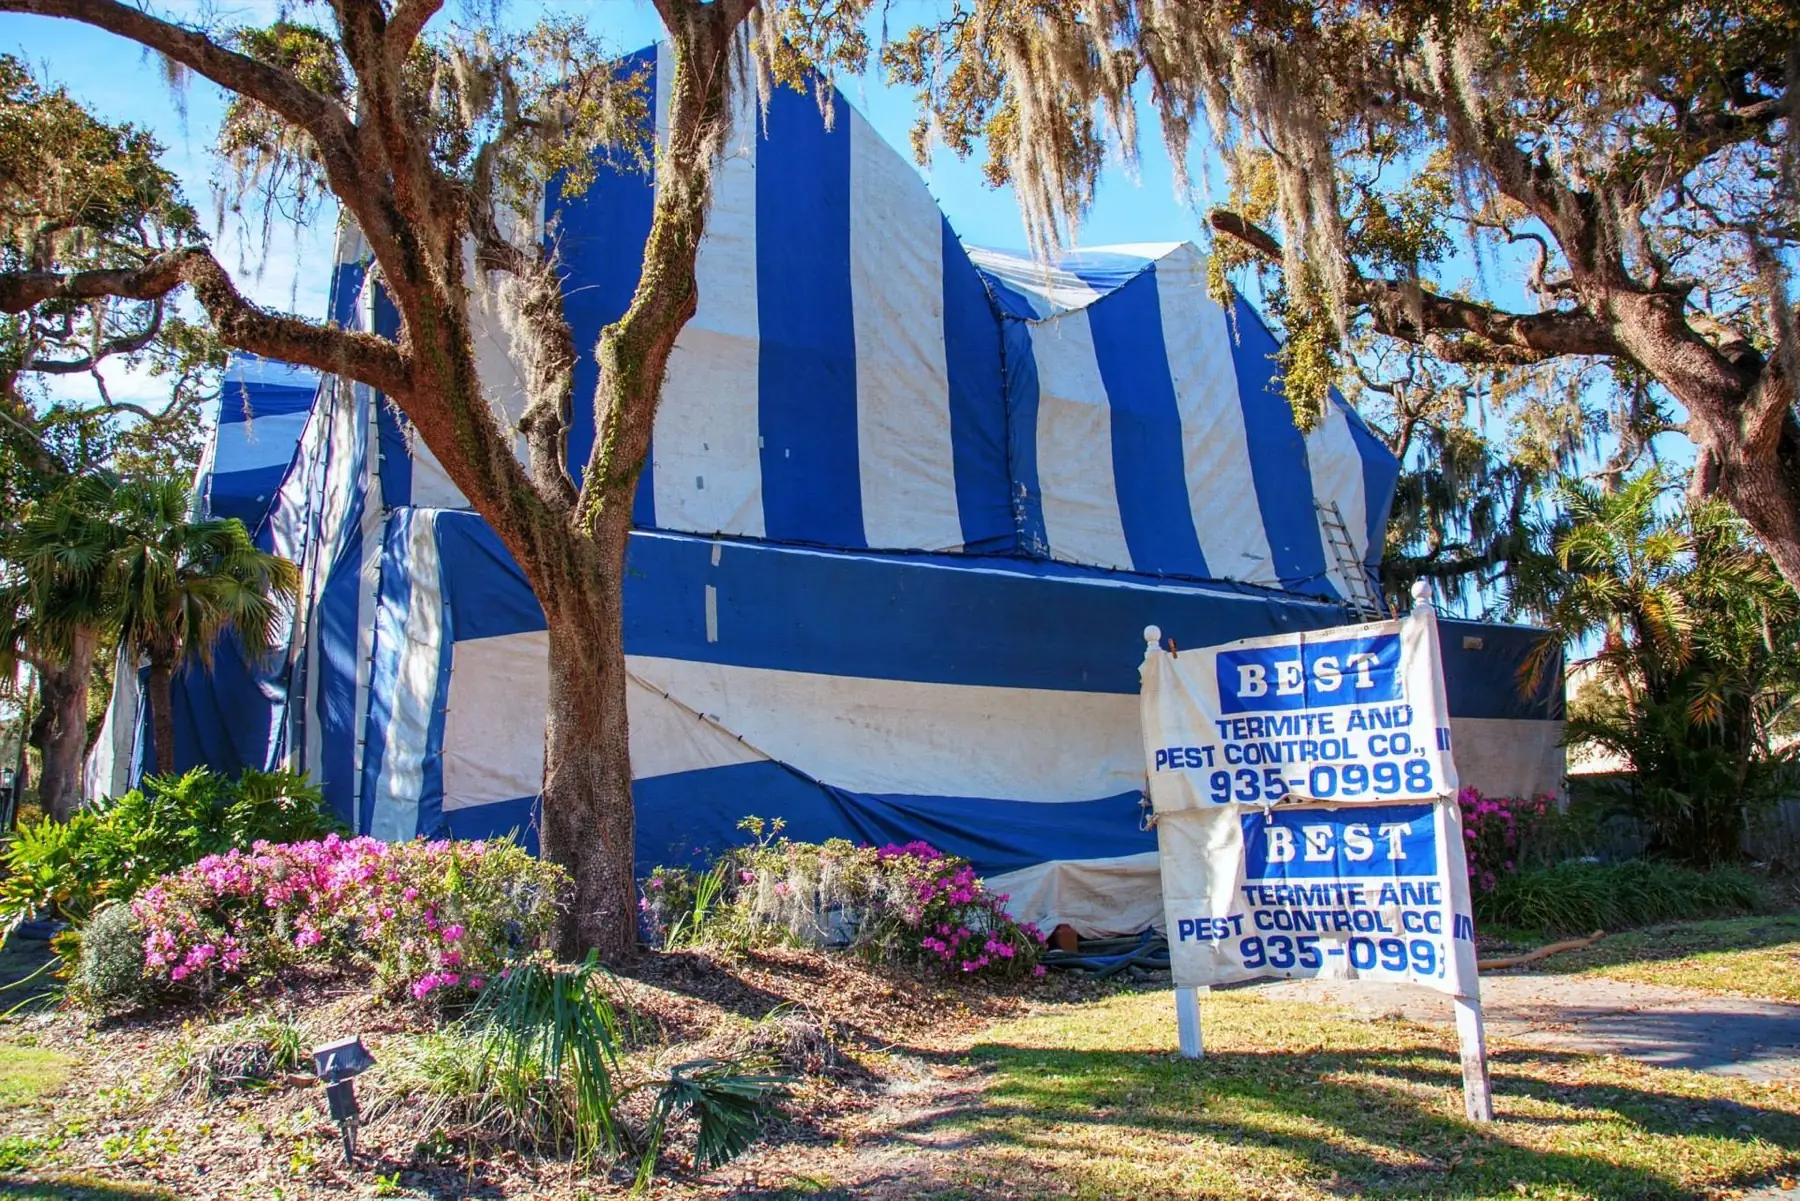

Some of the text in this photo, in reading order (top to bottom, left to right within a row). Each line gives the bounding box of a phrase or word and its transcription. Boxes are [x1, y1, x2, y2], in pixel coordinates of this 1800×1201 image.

[1236, 652, 1380, 698] BEST
[1215, 704, 1413, 740] TERMITE AND
[1155, 744, 1215, 771] PEST
[1224, 737, 1358, 765] CONTROL
[1367, 732, 1426, 758] CO.,
[1210, 758, 1433, 803] 935-0998
[1265, 822, 1412, 863] BEST
[1241, 883, 1364, 906] TERMITE
[1178, 914, 1244, 942] PEST
[1253, 910, 1392, 933] CONTROL
